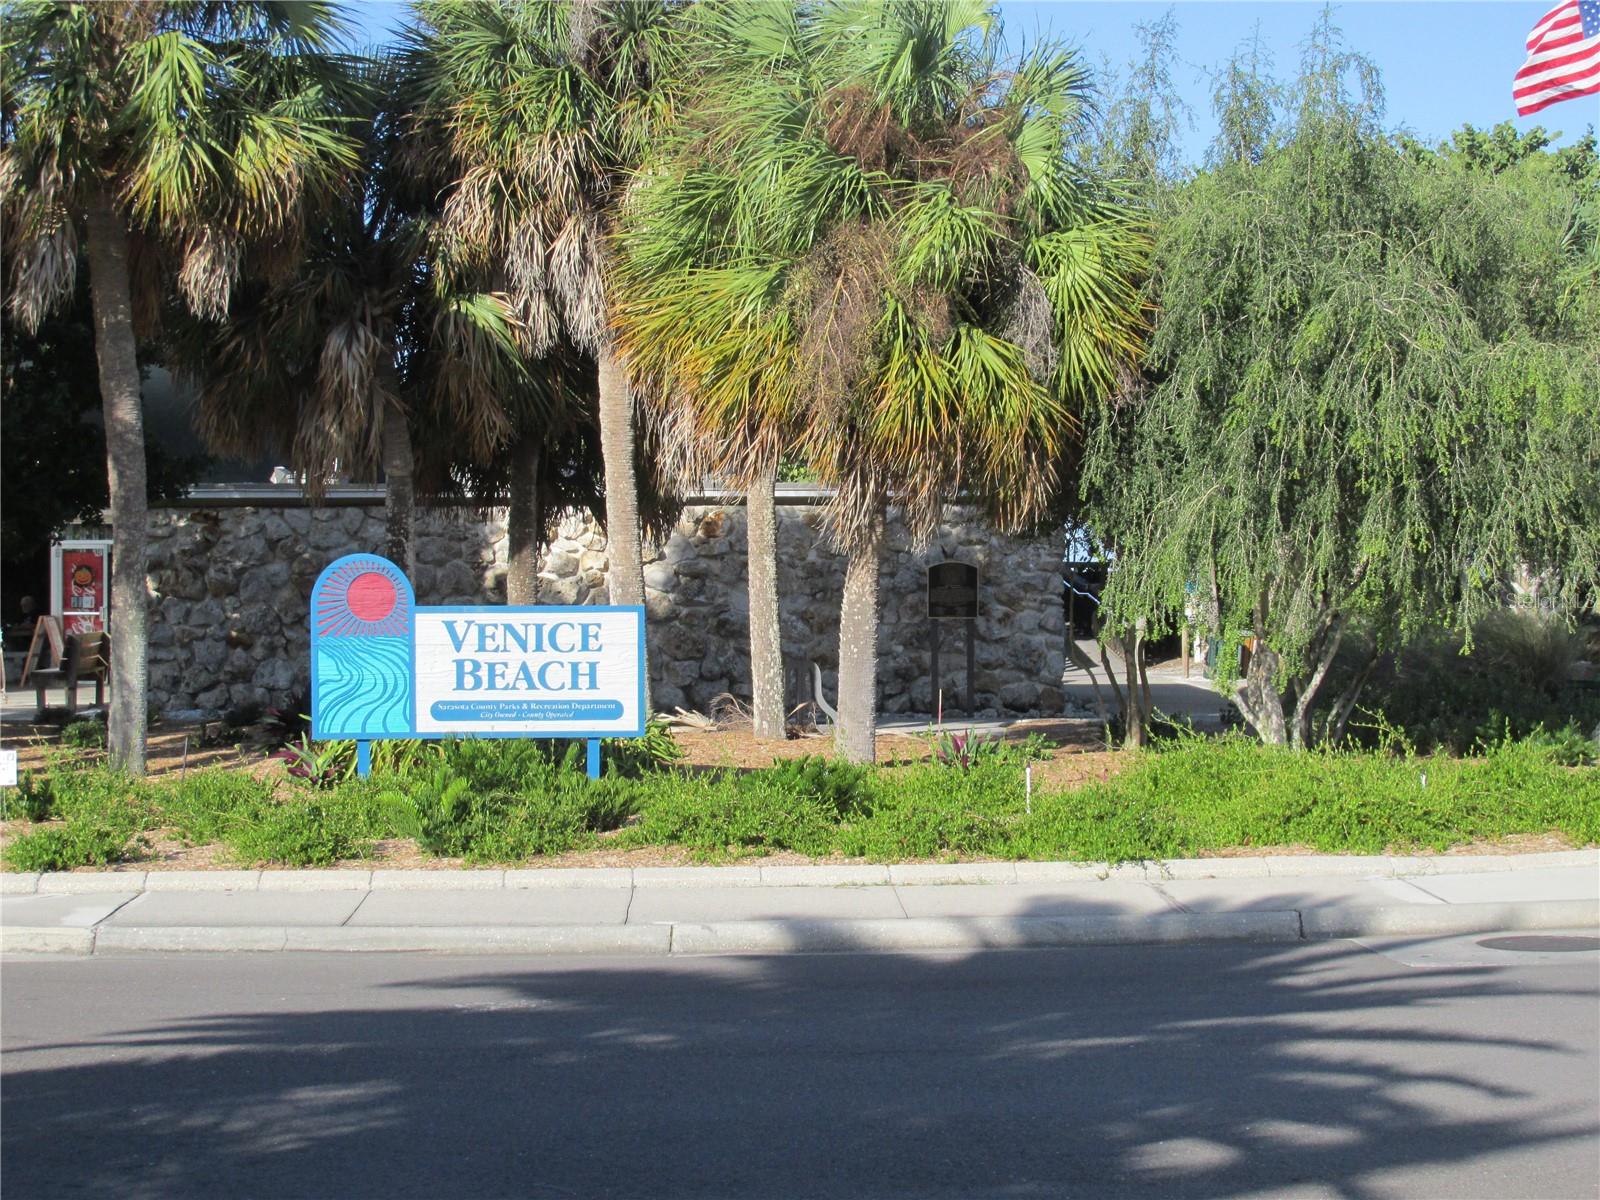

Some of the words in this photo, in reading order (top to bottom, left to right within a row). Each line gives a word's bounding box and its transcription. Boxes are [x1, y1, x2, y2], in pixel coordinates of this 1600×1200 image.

[441, 620, 603, 653] VENICE
[452, 658, 600, 691] BEACH
[470, 703, 497, 712] County
[571, 703, 616, 711] Department
[480, 711, 493, 719] City
[522, 711, 544, 719] County
[545, 711, 574, 719] Operated
